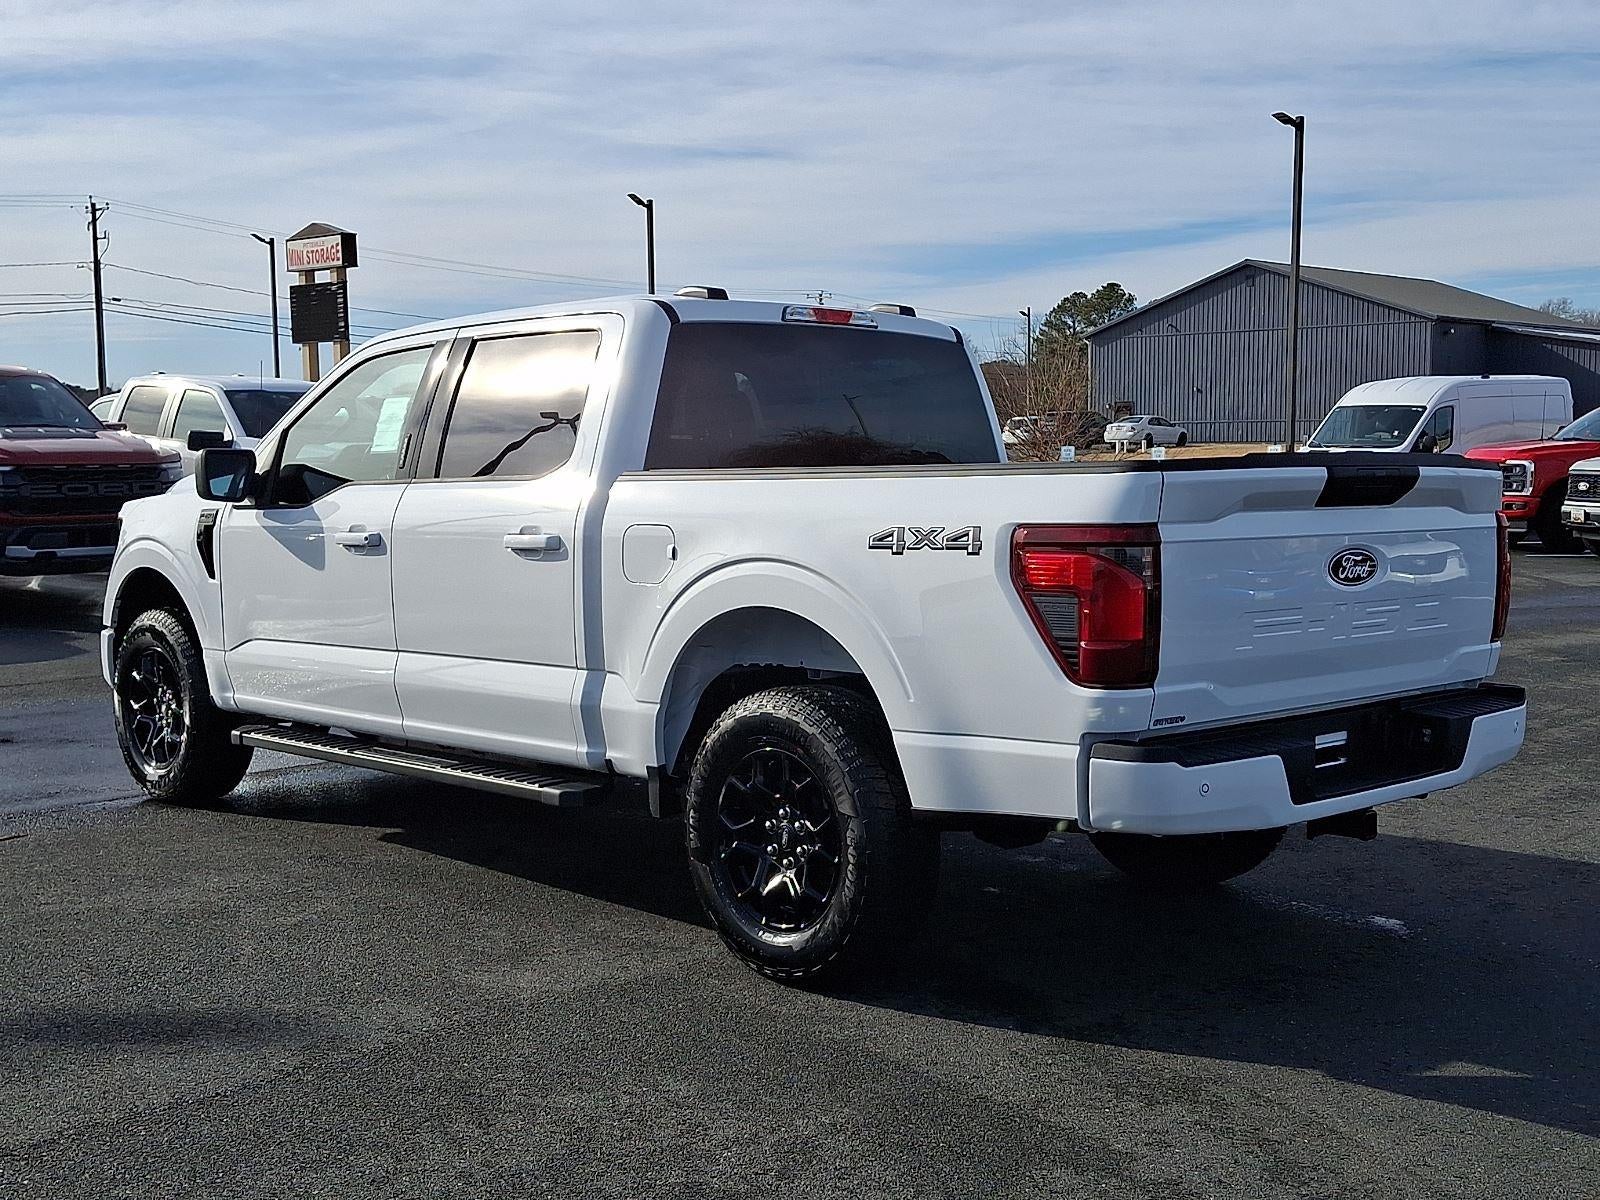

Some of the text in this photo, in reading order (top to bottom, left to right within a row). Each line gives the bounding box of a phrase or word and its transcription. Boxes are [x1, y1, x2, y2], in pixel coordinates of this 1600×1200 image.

[288, 242, 340, 266] MINI STORAGE
[1338, 554, 1370, 579] Ford
